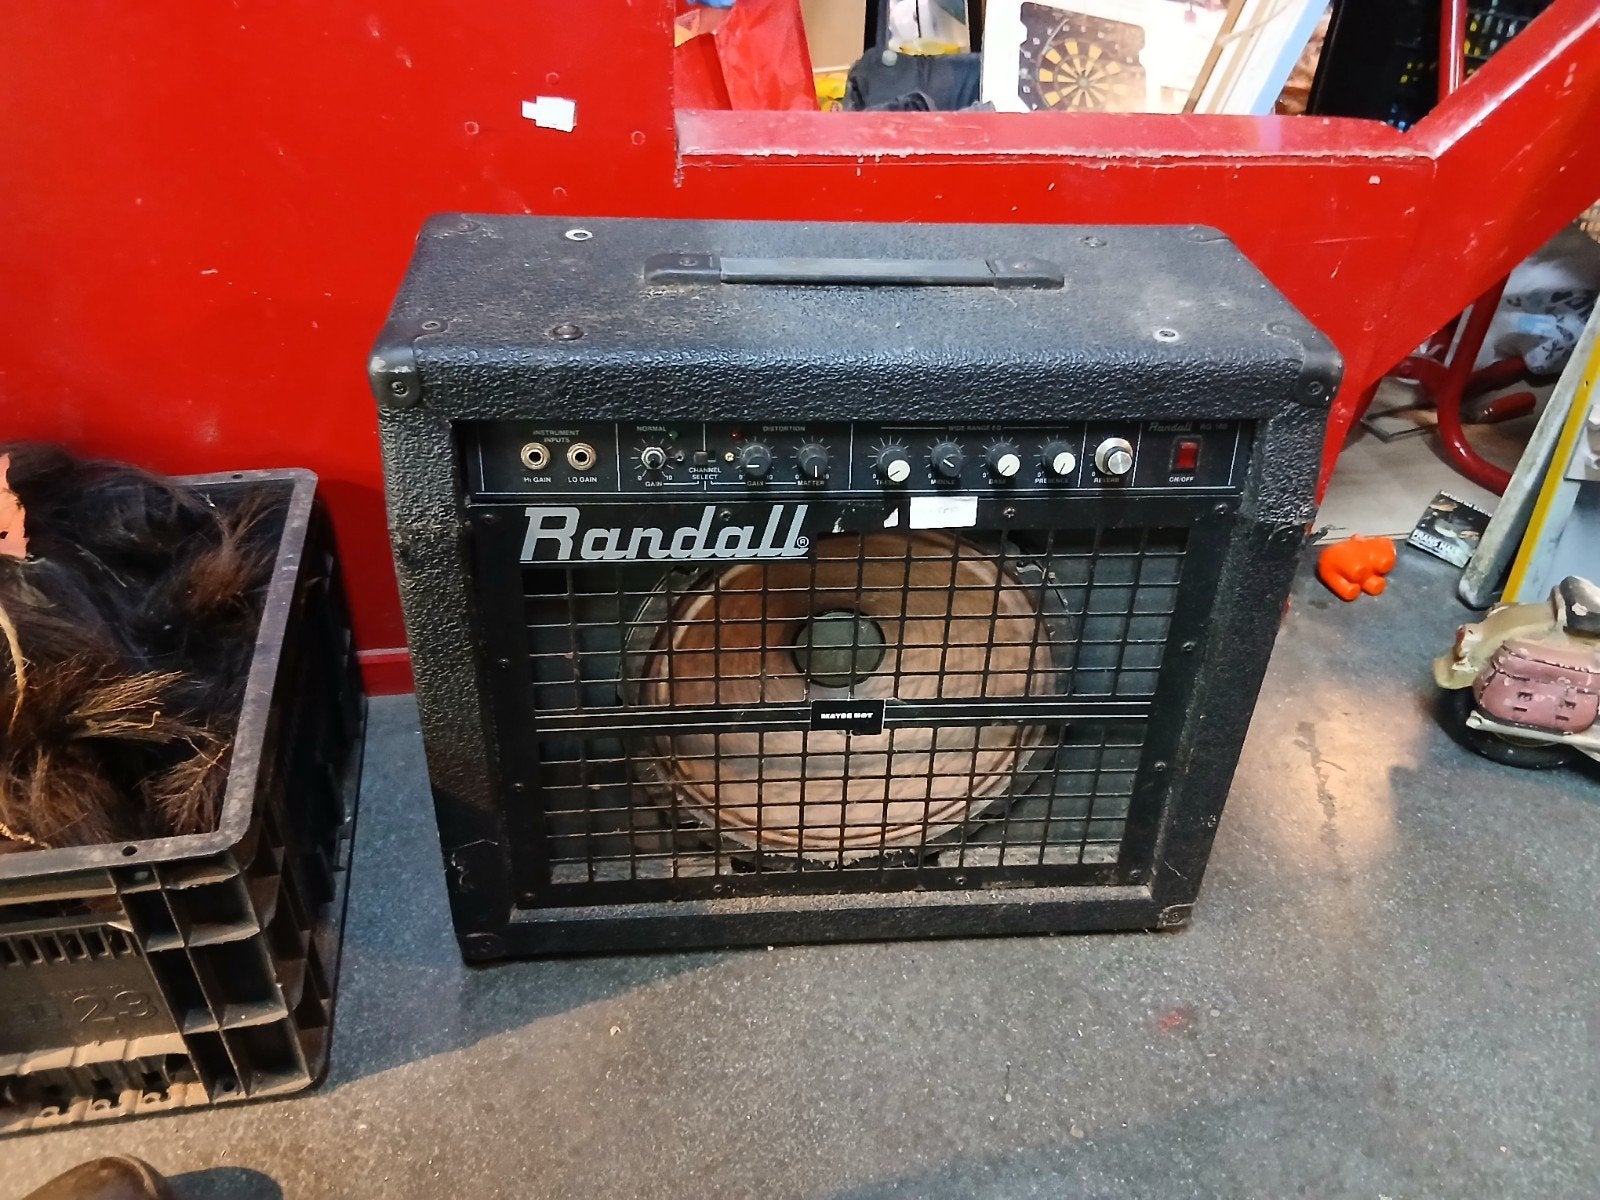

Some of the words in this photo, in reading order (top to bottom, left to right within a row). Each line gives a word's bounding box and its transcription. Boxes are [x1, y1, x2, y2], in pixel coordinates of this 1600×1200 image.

[1149, 422, 1192, 432] Randall
[520, 504, 809, 561] Randall
[72, 989, 159, 1023] 23
